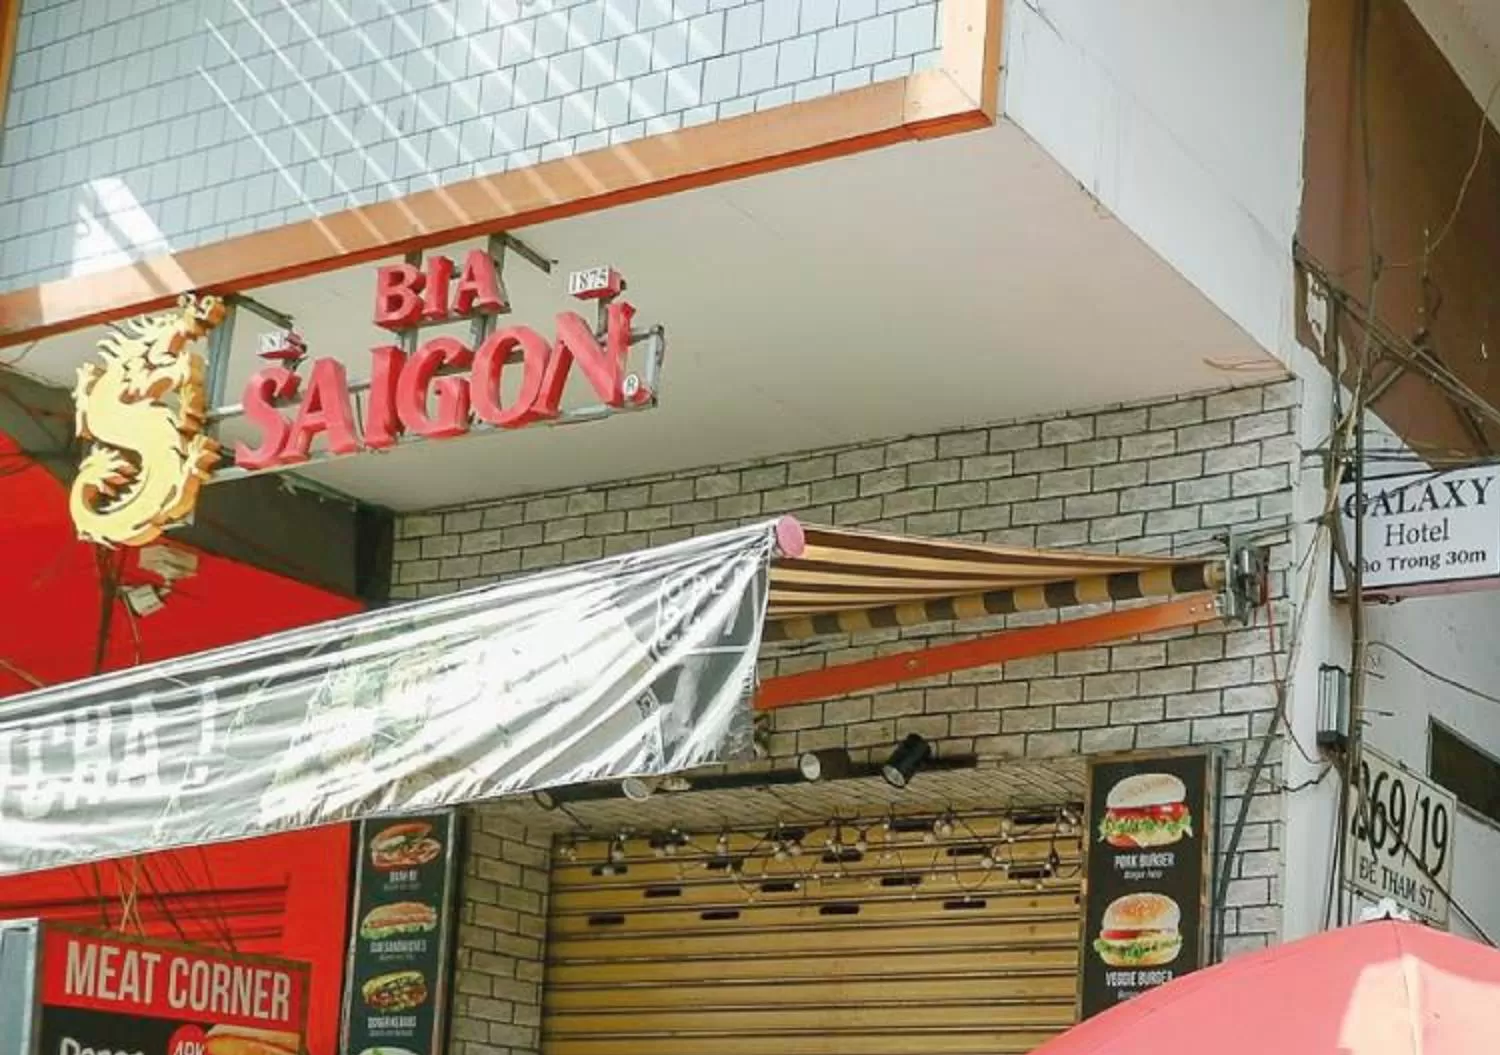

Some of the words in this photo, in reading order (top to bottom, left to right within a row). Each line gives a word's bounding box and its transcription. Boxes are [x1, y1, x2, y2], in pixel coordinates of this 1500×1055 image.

[375, 248, 510, 332] BIA
[234, 302, 636, 470] SAIGON
[1344, 477, 1495, 519] GALAXY
[1384, 518, 1451, 547] Hotel
[1388, 552, 1441, 573] Trong
[1445, 548, 1487, 566] 30m
[65, 941, 161, 1005] MEAT
[168, 956, 291, 1021] CORNER
